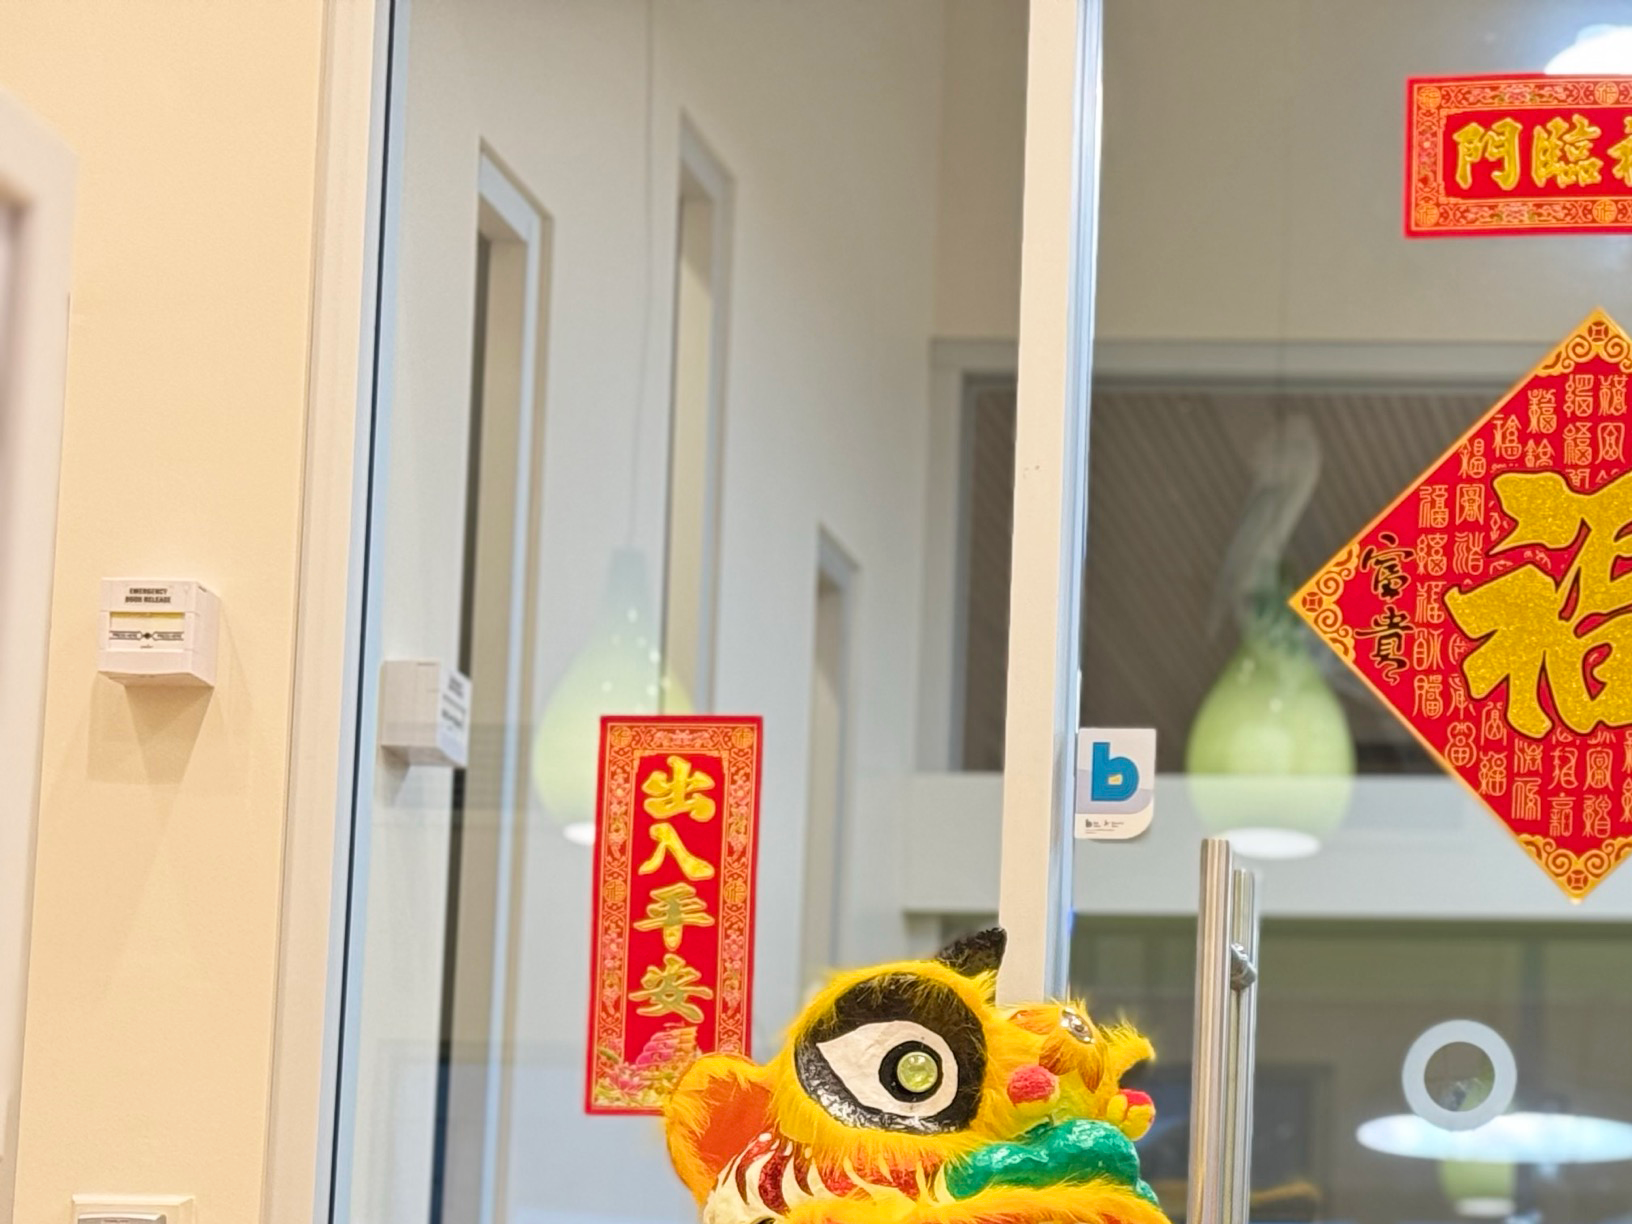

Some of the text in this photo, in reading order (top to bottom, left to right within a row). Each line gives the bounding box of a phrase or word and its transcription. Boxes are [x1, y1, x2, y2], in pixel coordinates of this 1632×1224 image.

[1354, 532, 1416, 686] 富貴
[629, 755, 716, 1024] 出入平安
